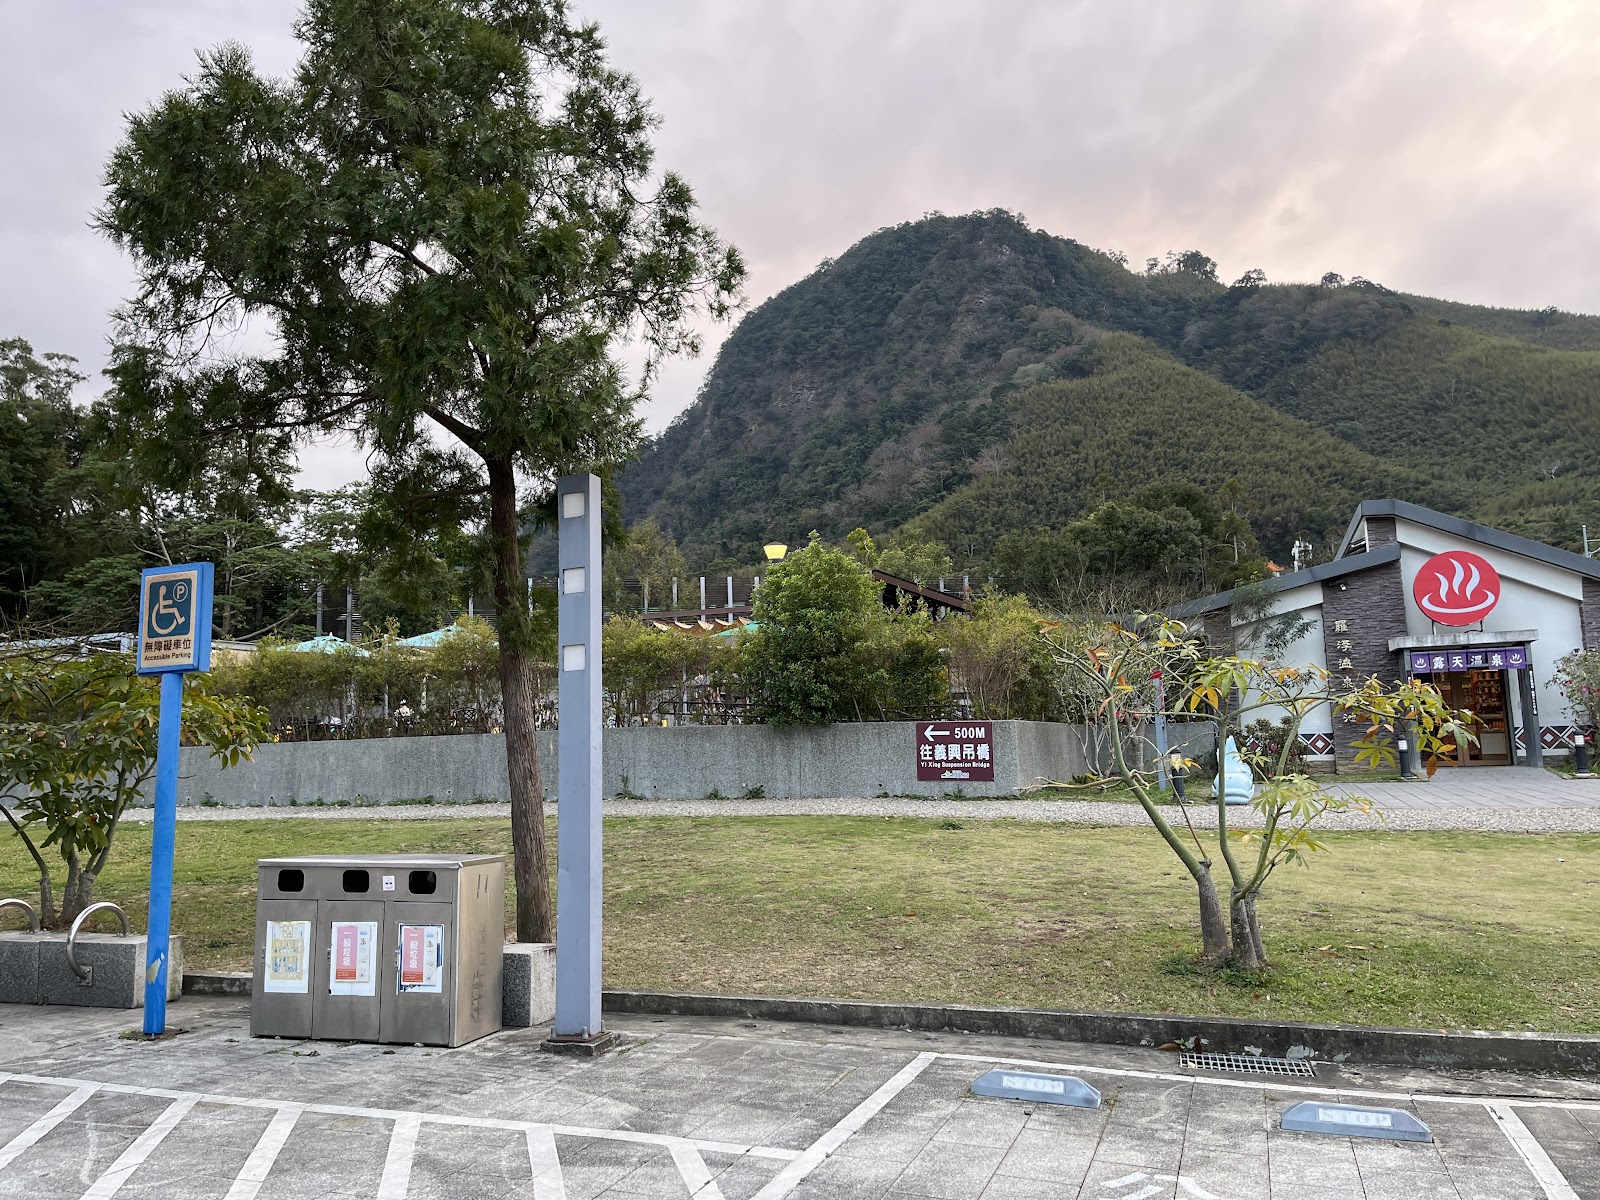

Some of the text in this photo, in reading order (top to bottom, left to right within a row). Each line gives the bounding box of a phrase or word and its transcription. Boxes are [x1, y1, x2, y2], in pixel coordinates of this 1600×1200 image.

[176, 585, 185, 599] P
[144, 638, 191, 653] 無障礙車位
[144, 652, 191, 661] Accessible Parking
[954, 727, 985, 739] 500M
[920, 743, 990, 761] 往義興吊橋
[928, 761, 941, 769] Xing
[942, 761, 972, 769] Suspension
[972, 761, 991, 769] Bridge
[342, 931, 352, 967] 一般垃圾
[409, 933, 419, 970] 一般垃圾
[1005, 1076, 1064, 1092] STOP
[1321, 1109, 1388, 1126] STOP
